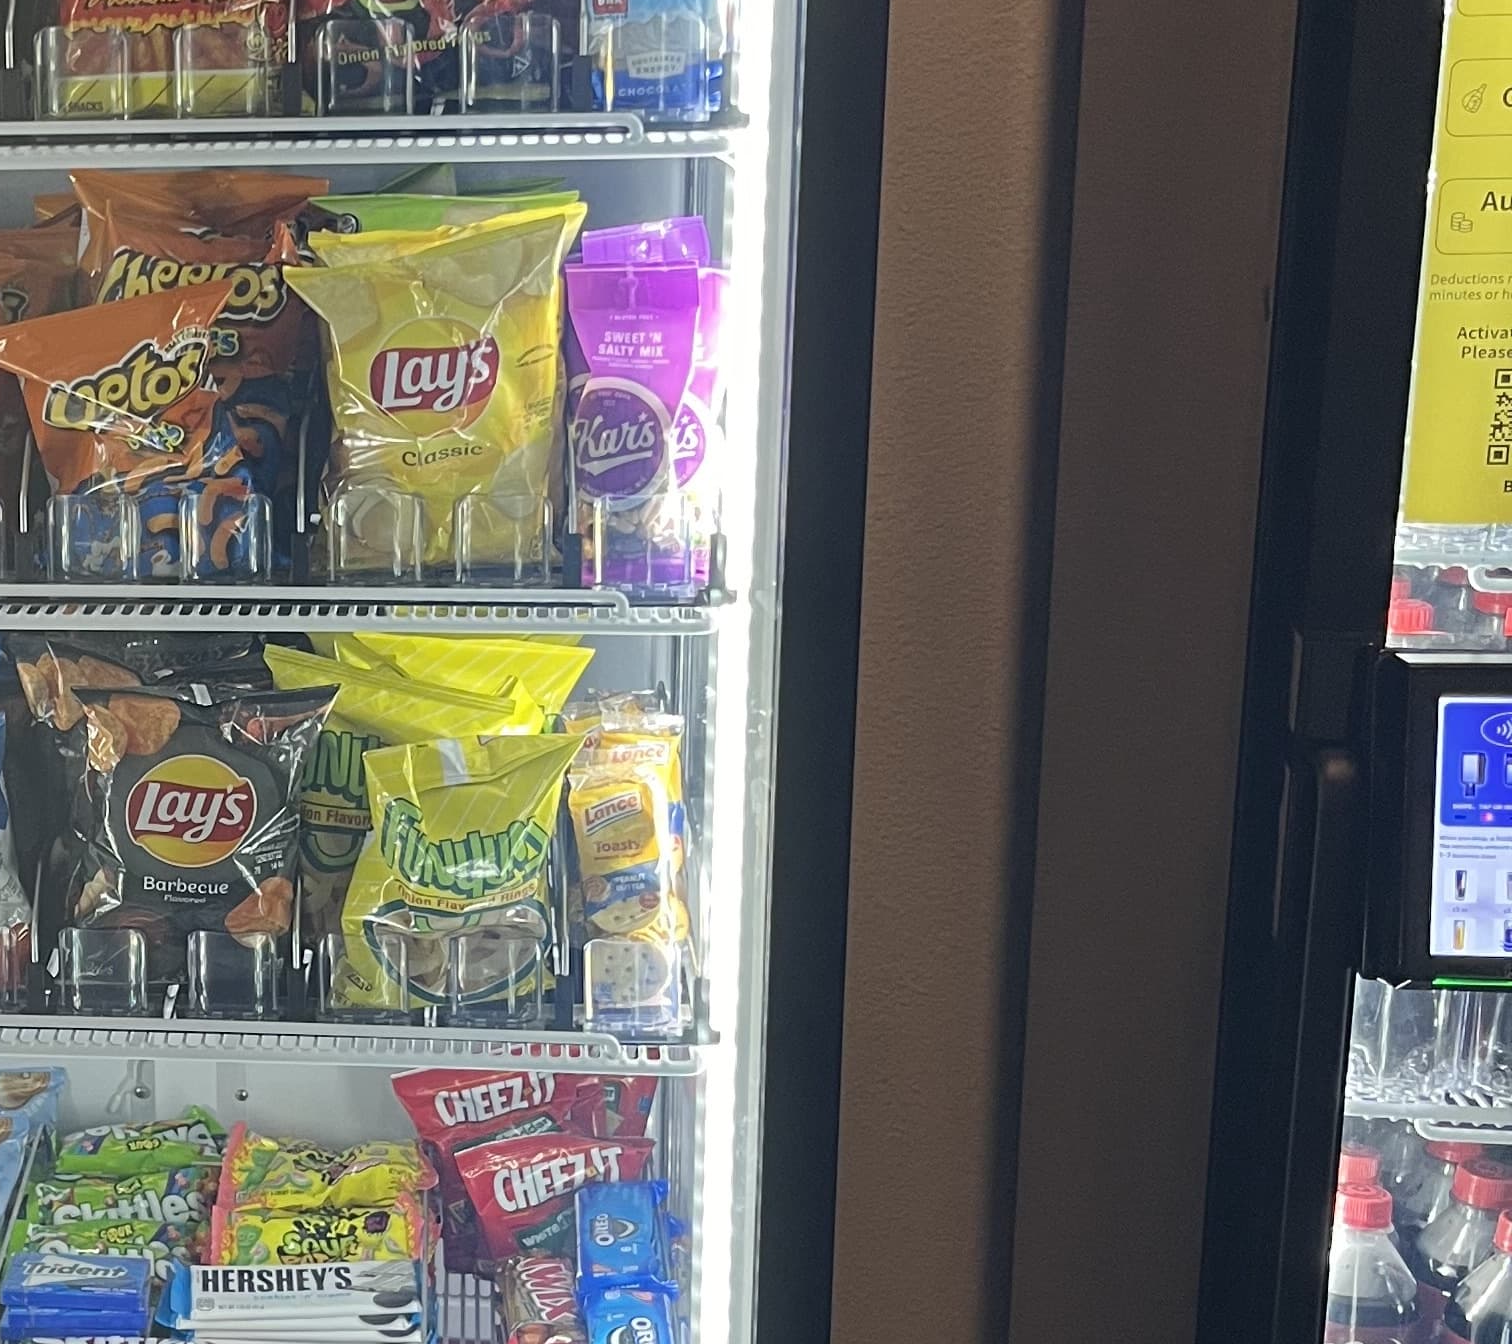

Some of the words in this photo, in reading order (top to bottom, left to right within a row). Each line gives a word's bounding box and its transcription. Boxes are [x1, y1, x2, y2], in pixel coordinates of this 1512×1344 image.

[338, 47, 380, 66] Onion
[1481, 191, 1512, 212] Au
[1431, 273, 1504, 286] Deductions
[1429, 289, 1482, 302] minutes
[1486, 290, 1499, 302] or
[604, 331, 645, 344] SWEET
[1457, 325, 1512, 341] Activa
[598, 343, 635, 357] SALTY
[639, 344, 664, 358] MIX
[382, 334, 493, 413] Lay's
[575, 412, 656, 459] Kar's
[402, 442, 483, 467] Classic
[612, 743, 666, 763] Lance
[135, 782, 248, 842] Lay's
[585, 794, 639, 826] Lance
[143, 876, 229, 895] Barbecue
[398, 883, 432, 907] Onion
[500, 883, 537, 903] Rings
[23, 1261, 126, 1277] Trident
[202, 1267, 352, 1293] HERSHEY'S
[517, 1256, 576, 1322] TWIX
